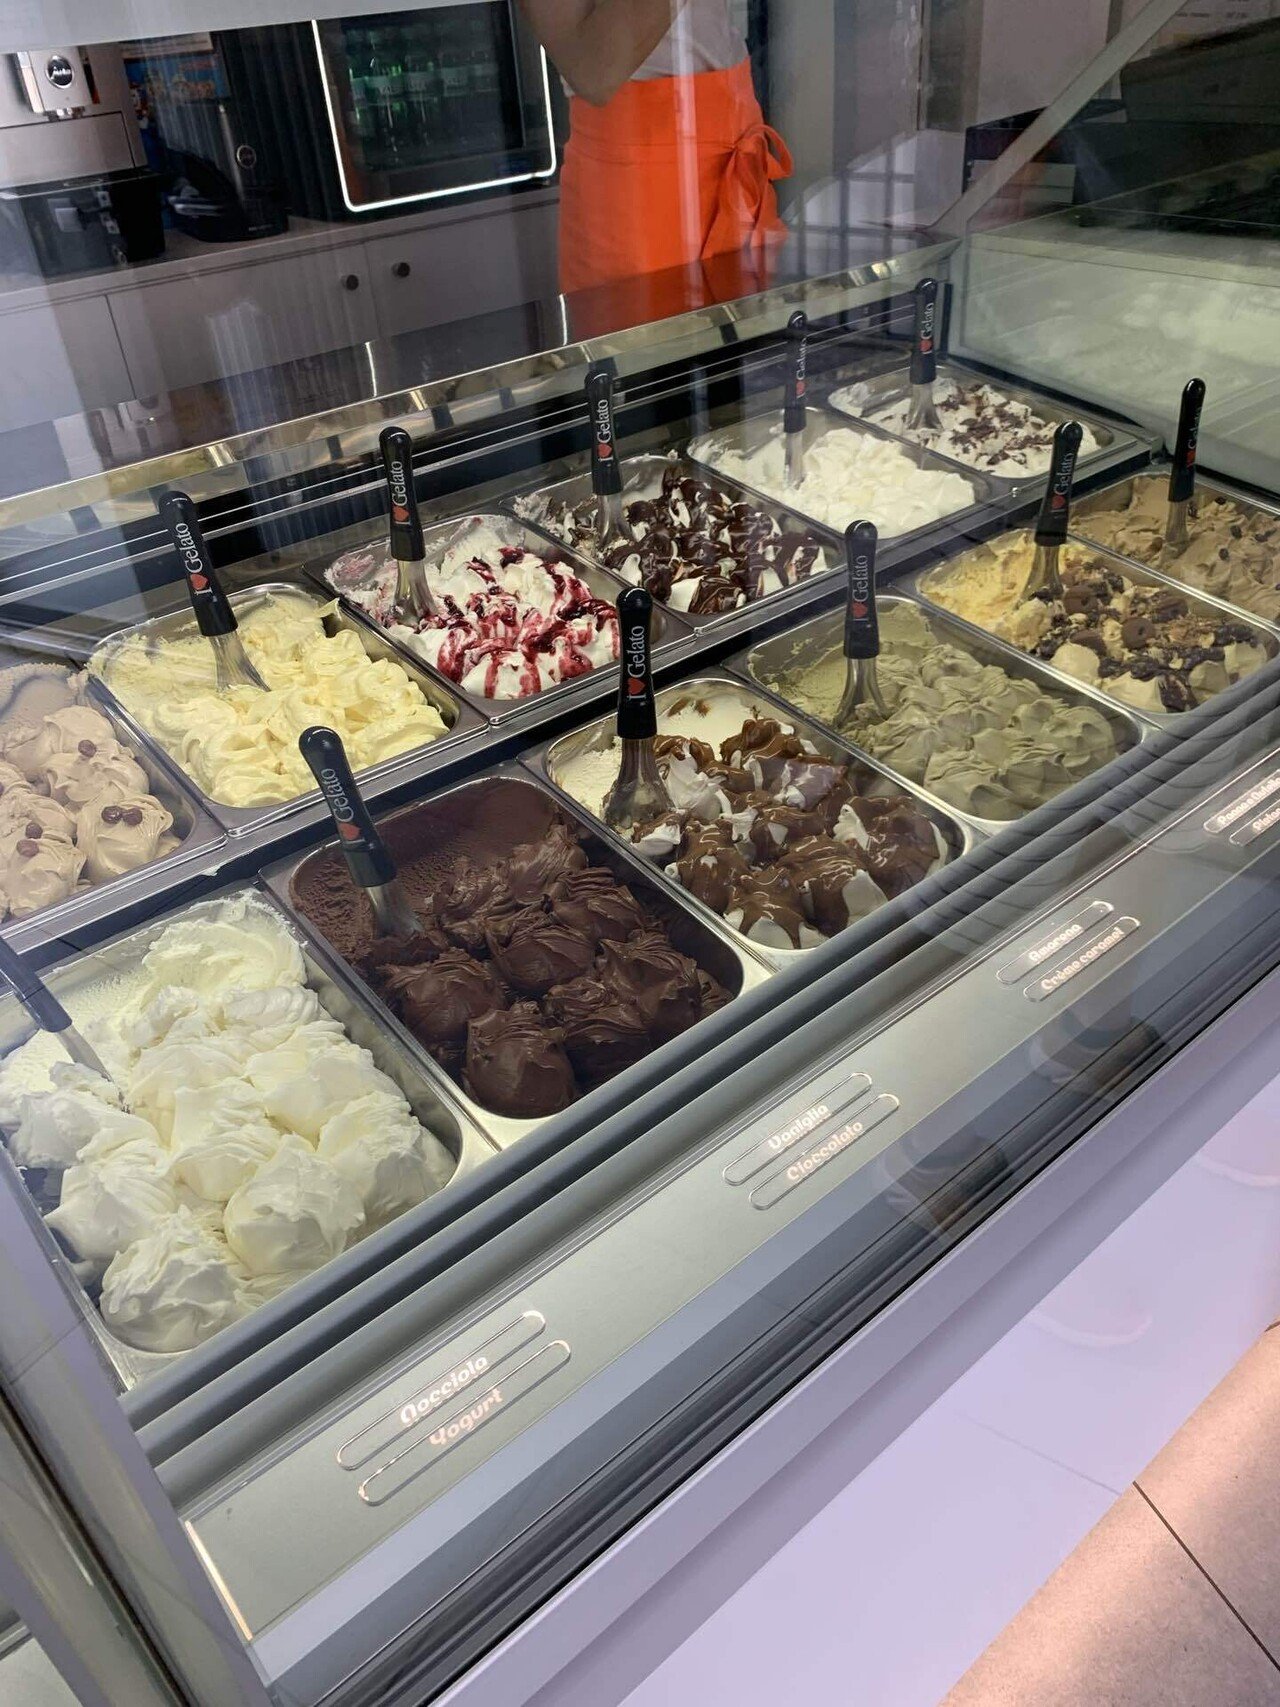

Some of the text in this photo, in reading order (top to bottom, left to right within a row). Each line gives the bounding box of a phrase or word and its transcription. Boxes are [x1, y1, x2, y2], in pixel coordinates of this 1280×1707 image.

[920, 302, 935, 340] Gelato
[595, 399, 612, 444] Gelato
[390, 460, 408, 507] Gelato
[1053, 452, 1075, 496] Gelato
[175, 522, 213, 597] I Gelato
[851, 555, 869, 603] Gelato
[626, 625, 647, 701] I Gelato
[320, 768, 355, 823] Gelato
[1028, 924, 1084, 961] Amarena
[1079, 926, 1125, 963] caramel
[787, 1121, 864, 1180] Cioccolato
[429, 1387, 503, 1445] Yogurt
